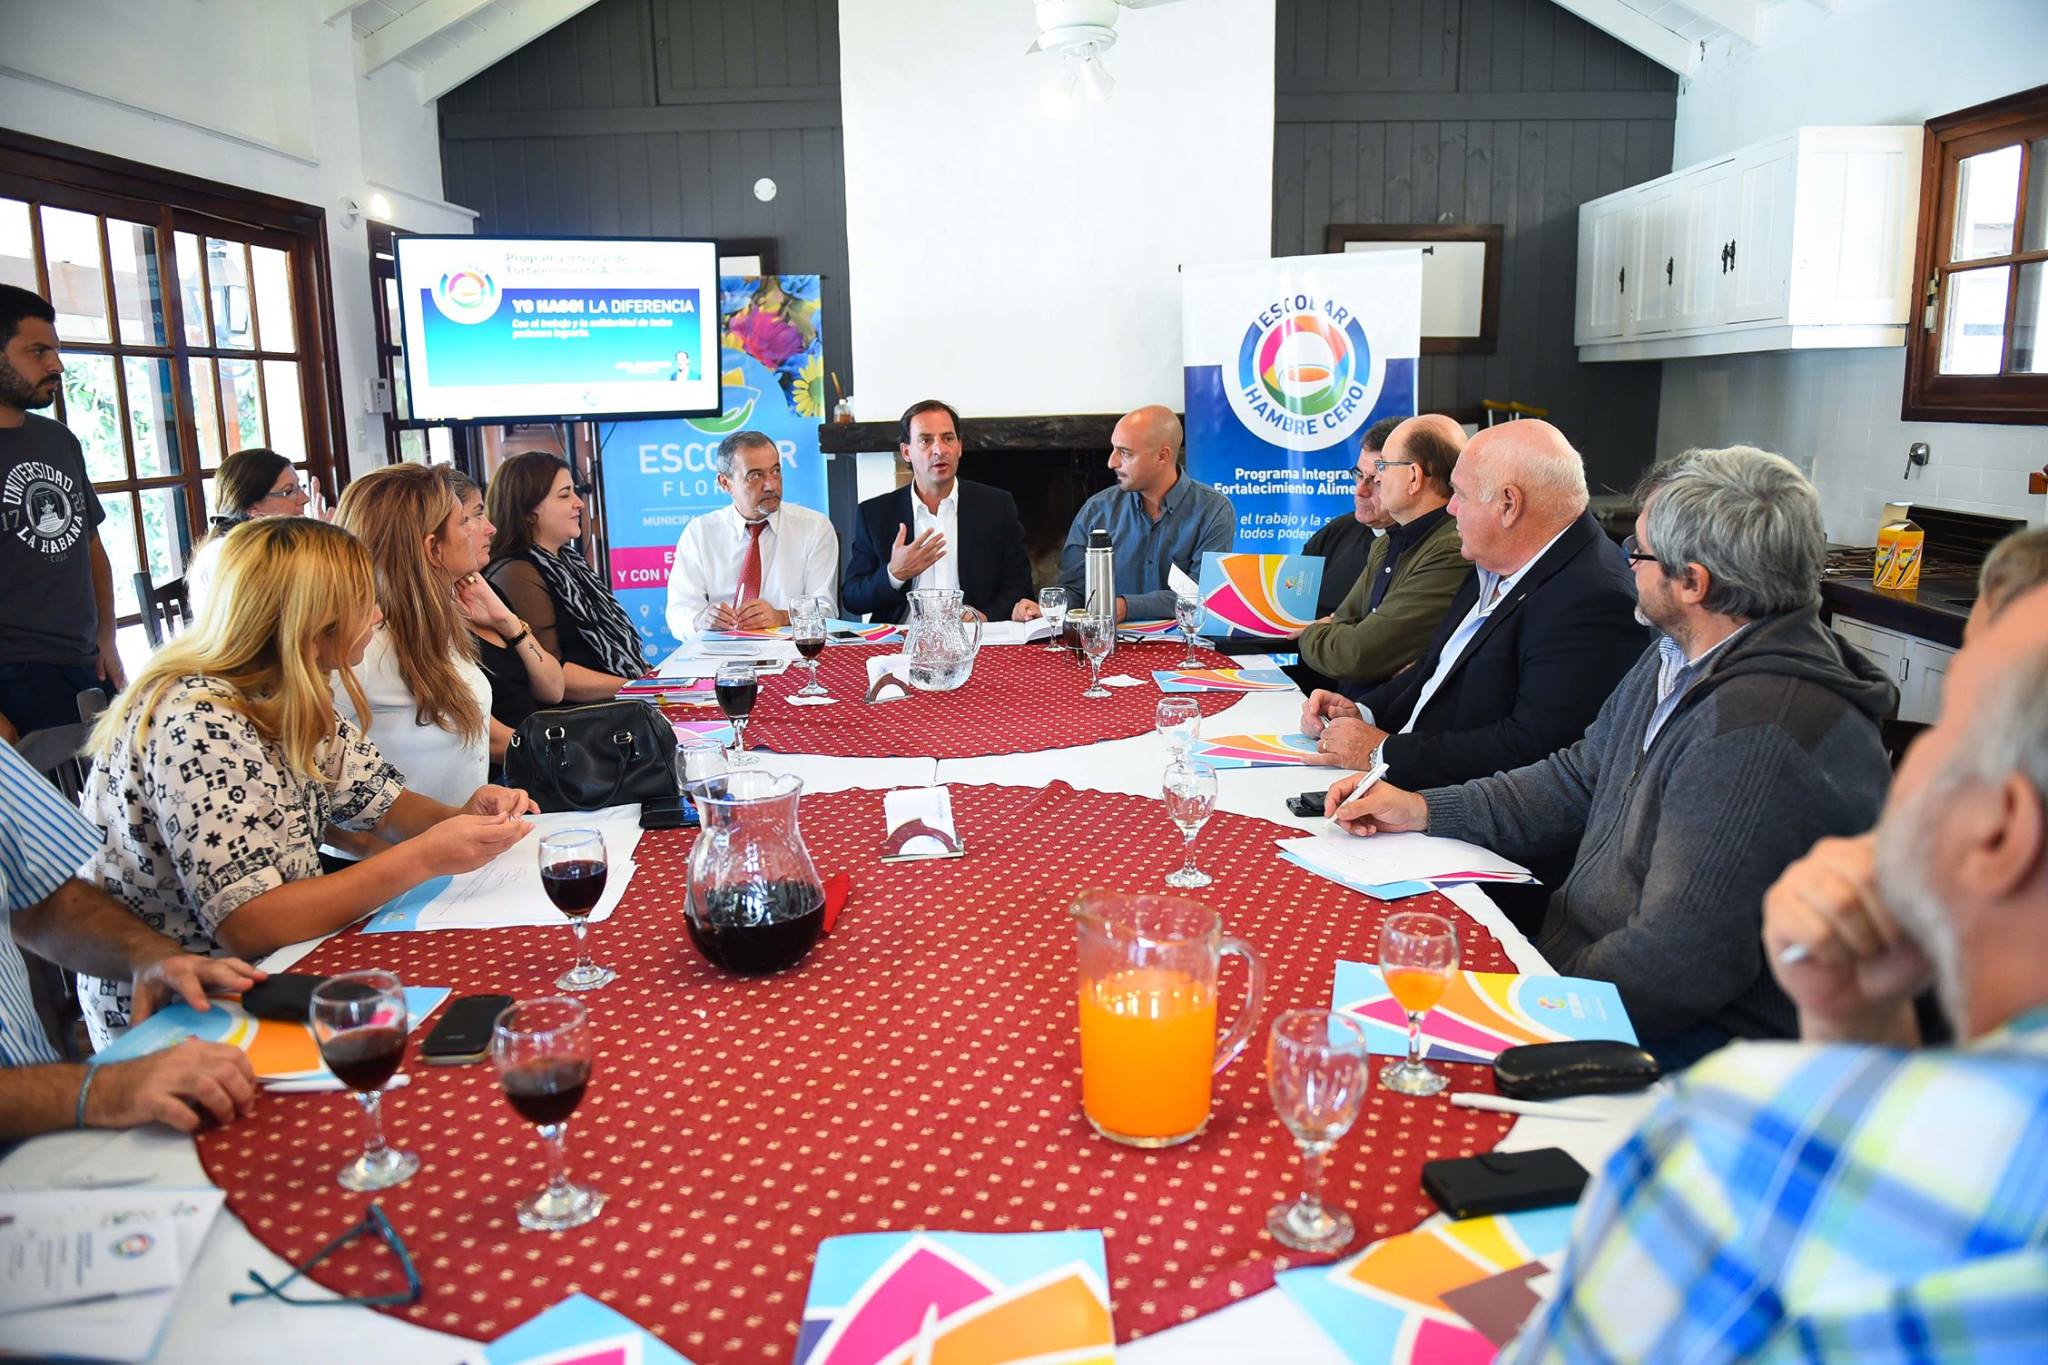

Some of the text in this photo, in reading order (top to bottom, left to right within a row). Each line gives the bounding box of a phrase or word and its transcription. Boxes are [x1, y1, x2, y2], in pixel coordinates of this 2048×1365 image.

[588, 298, 608, 314] LA
[611, 298, 695, 314] DIFERENCIA
[1245, 385, 1363, 435] HAMBRE CERO
[638, 439, 798, 474] ESCOR
[1235, 467, 1353, 483] Programa Integra
[3, 461, 74, 506] UNIVERSIDAD
[1214, 482, 1314, 495] Fortalecimiento
[1, 509, 20, 532] 17
[1240, 513, 1252, 525] el
[1255, 512, 1298, 527] trabajo
[1300, 516, 1308, 527] y
[1310, 513, 1321, 526] la
[16, 515, 83, 554] LA HABANA
[1240, 527, 1275, 539] todos
[617, 569, 627, 583] Y
[630, 568, 660, 582] CON
